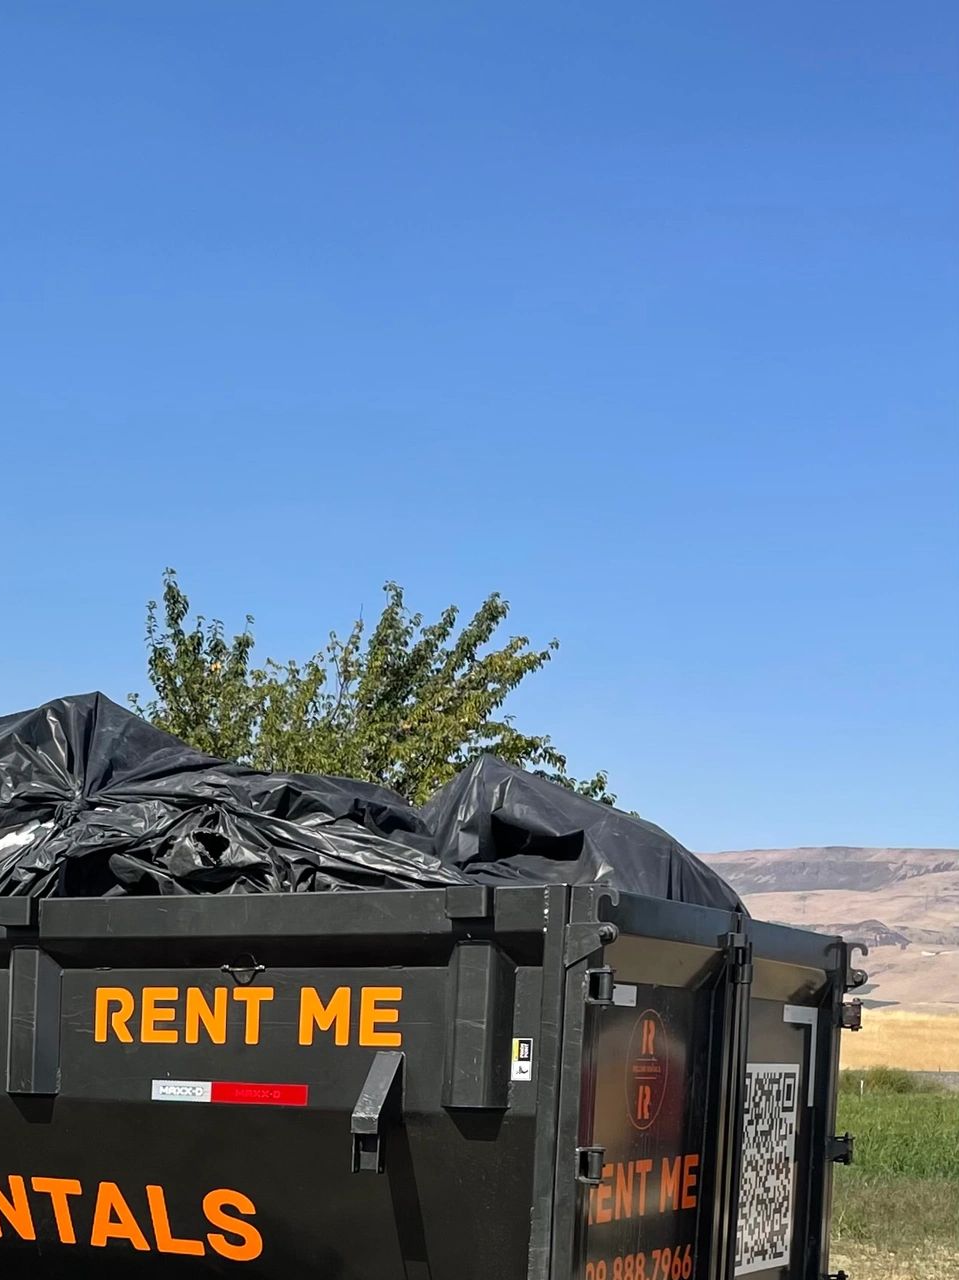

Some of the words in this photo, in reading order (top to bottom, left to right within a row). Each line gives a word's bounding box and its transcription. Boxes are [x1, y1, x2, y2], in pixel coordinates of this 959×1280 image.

[94, 986, 275, 1045] RENT
[298, 986, 403, 1047] ME
[642, 1019, 656, 1055] R
[158, 1086, 204, 1097] MAXX-D
[636, 1085, 652, 1120] R
[658, 1153, 700, 1213] ME
